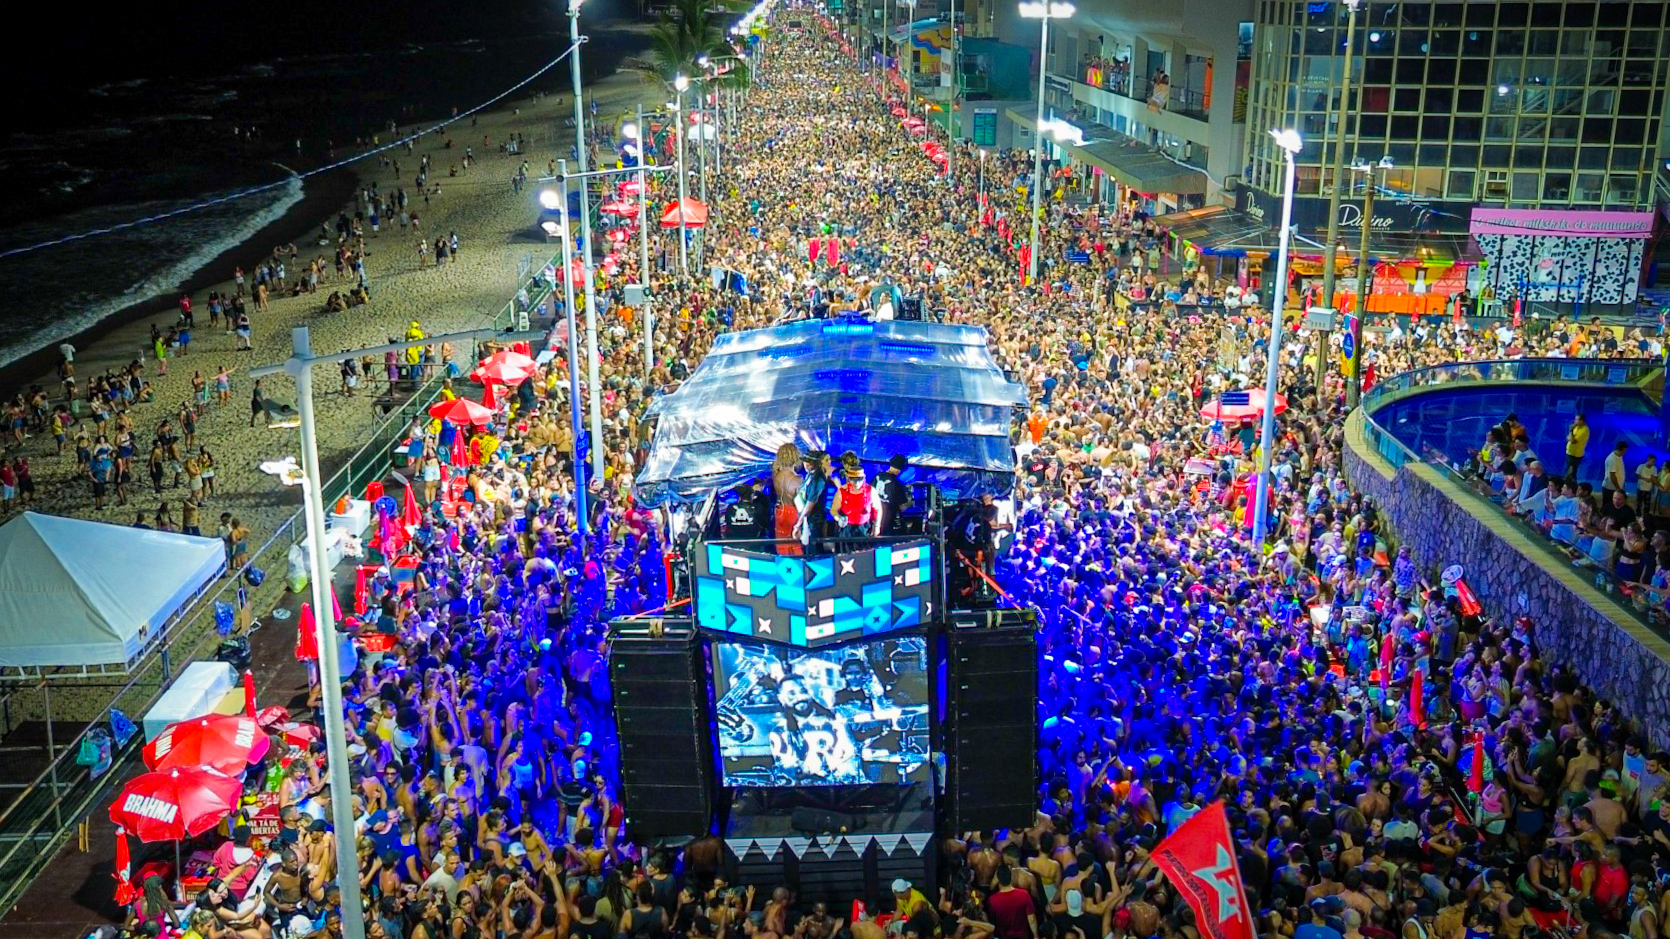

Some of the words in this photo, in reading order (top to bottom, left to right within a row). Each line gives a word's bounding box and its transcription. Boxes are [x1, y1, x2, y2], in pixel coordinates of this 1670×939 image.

[1338, 204, 1394, 227] Diino
[122, 793, 179, 824] BRAHMA
[250, 827, 281, 835] ABERTAS
